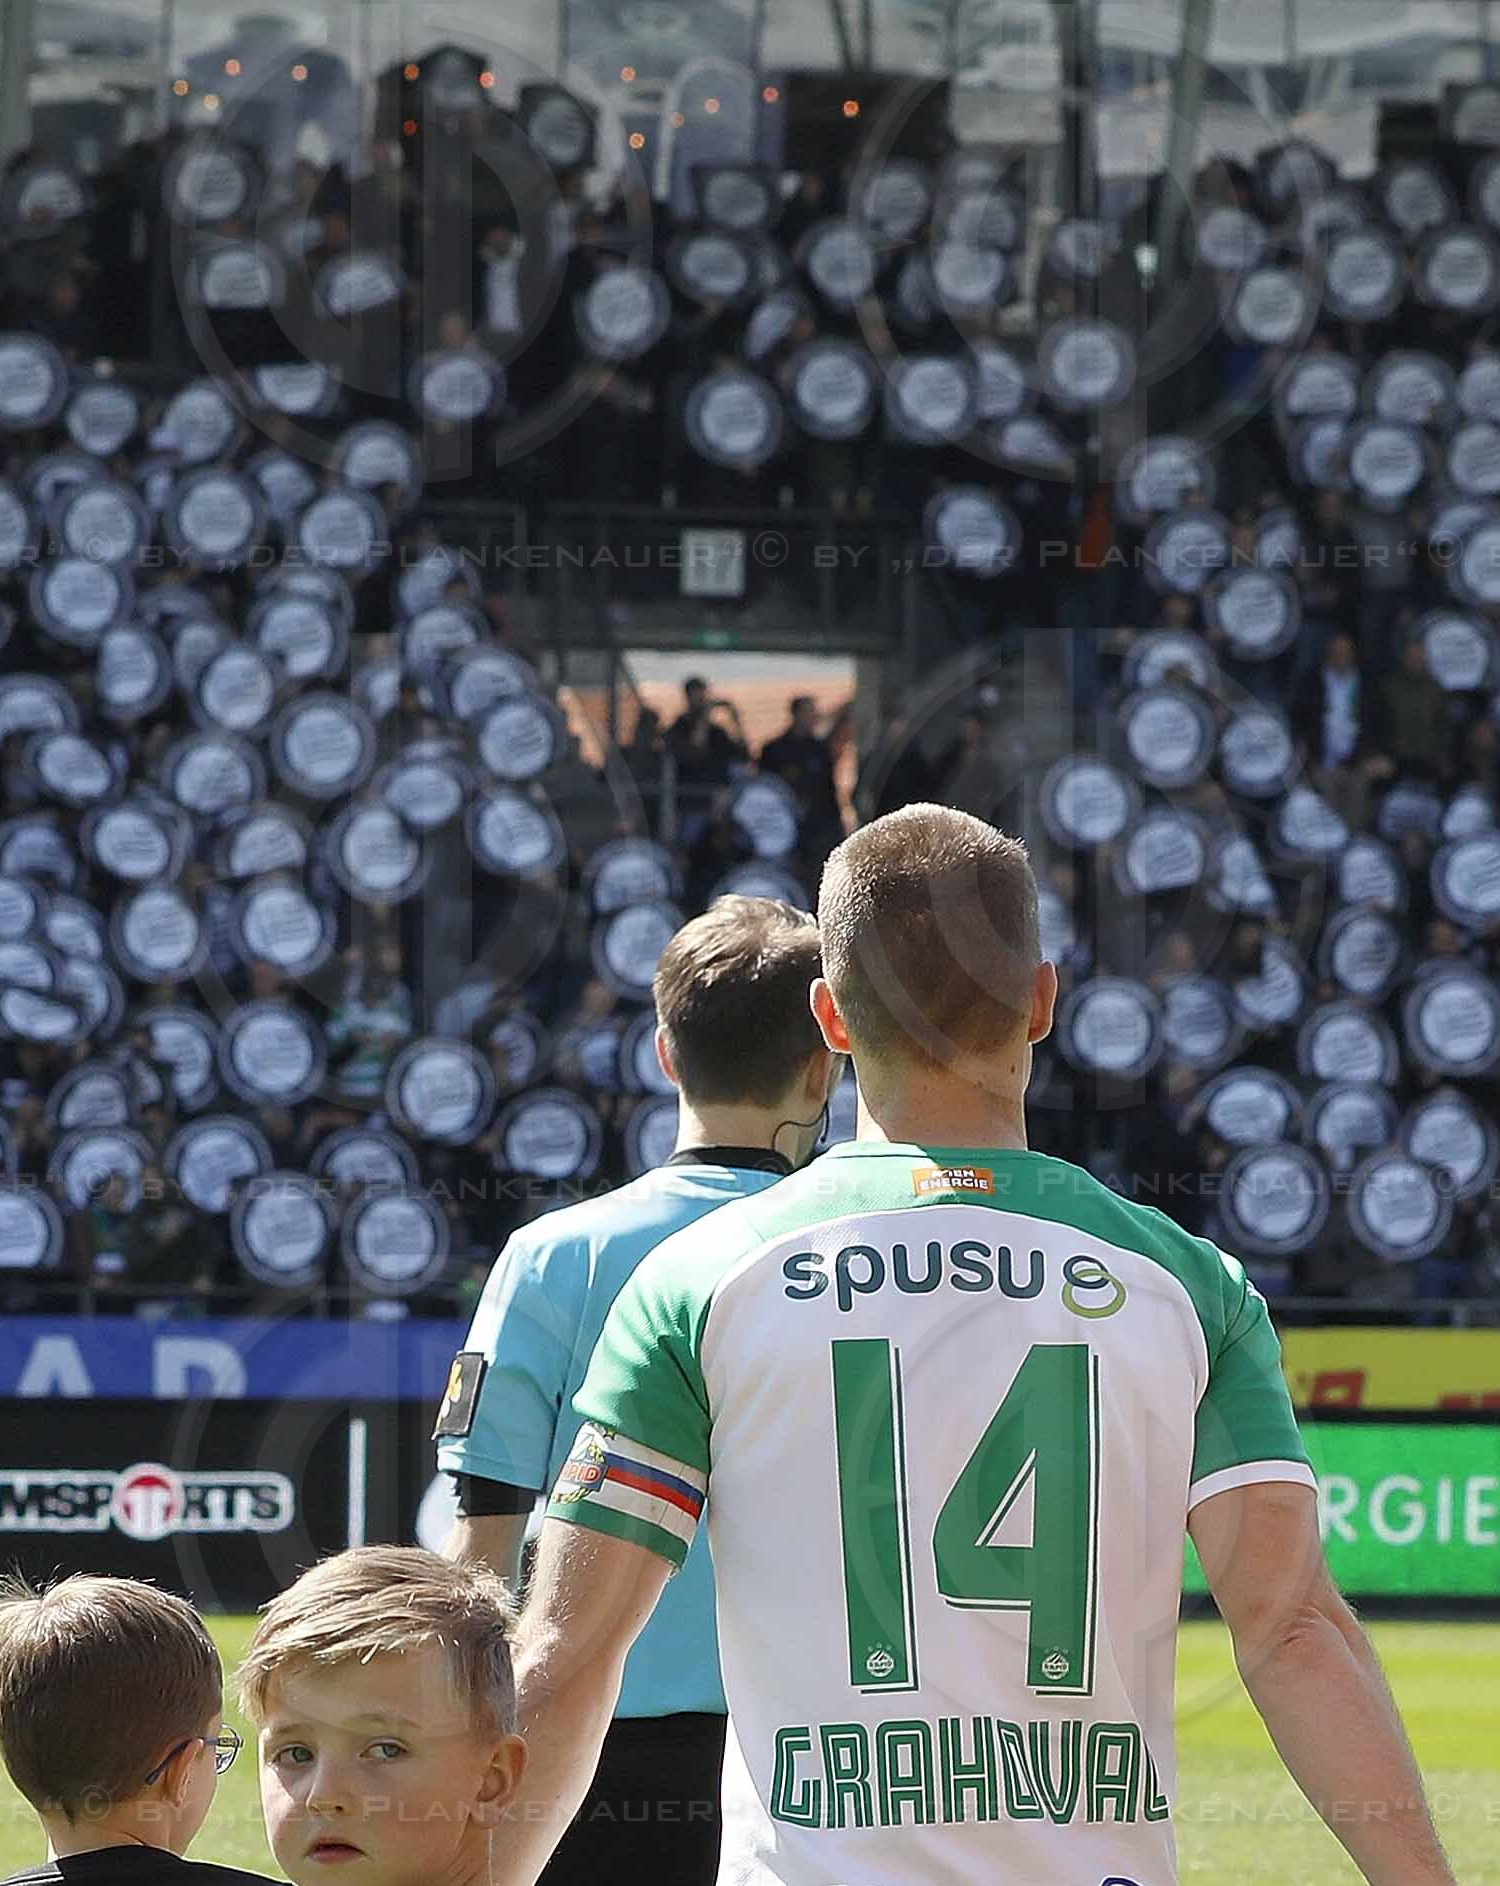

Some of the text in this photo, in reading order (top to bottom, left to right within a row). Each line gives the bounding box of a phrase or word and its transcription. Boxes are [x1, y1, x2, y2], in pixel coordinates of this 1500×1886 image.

[919, 1177, 989, 1190] ENERGIE
[782, 1240, 1046, 1313] spusu
[831, 1338, 1102, 1698] 14
[1317, 1473, 1500, 1546] RGIE
